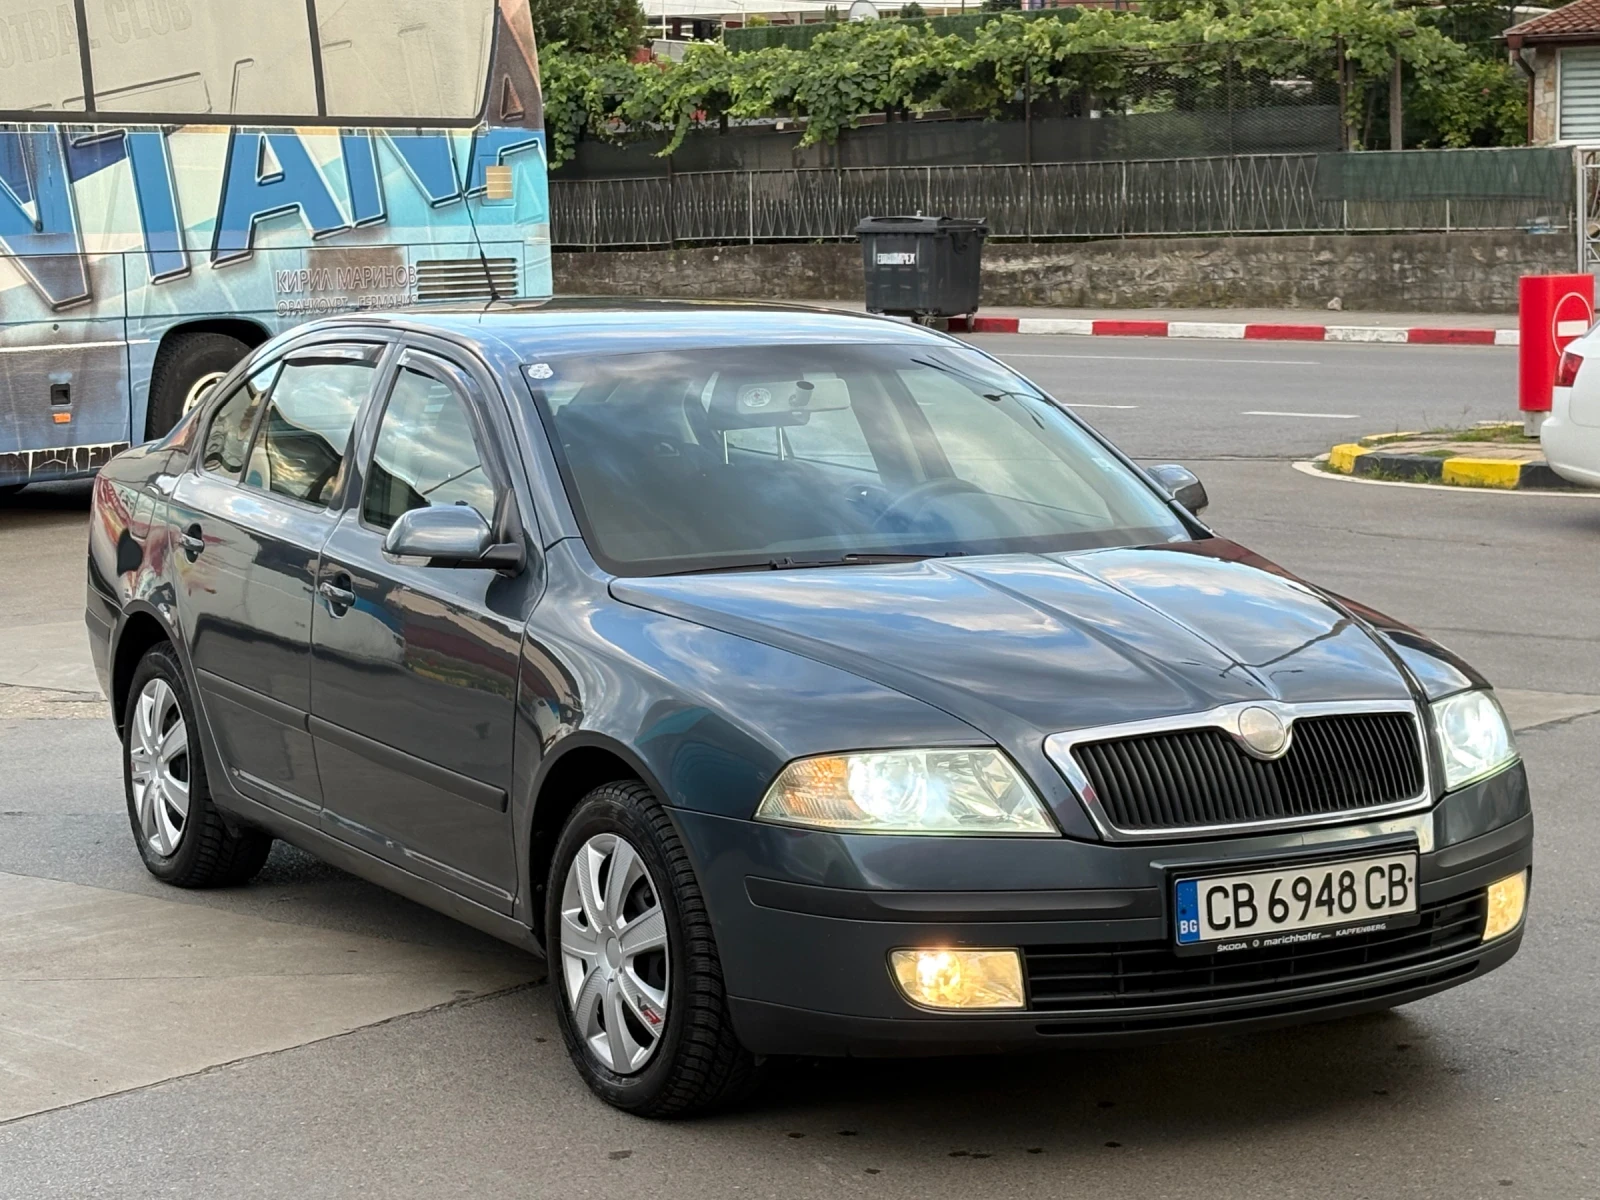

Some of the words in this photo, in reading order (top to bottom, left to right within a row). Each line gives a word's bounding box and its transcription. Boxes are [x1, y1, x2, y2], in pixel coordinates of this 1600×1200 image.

[104, 0, 193, 44] CLUB
[276, 268, 333, 293] КИРИЛ
[336, 265, 418, 291] МАРИНОВ
[1206, 882, 1258, 931] CB
[1268, 869, 1357, 923] 6948
[1365, 863, 1408, 910] CB
[1180, 919, 1198, 935] BG
[1217, 942, 1248, 952] ŠKODA
[1264, 932, 1322, 946] marichhofer
[1336, 923, 1387, 936] KAPFENBERG
